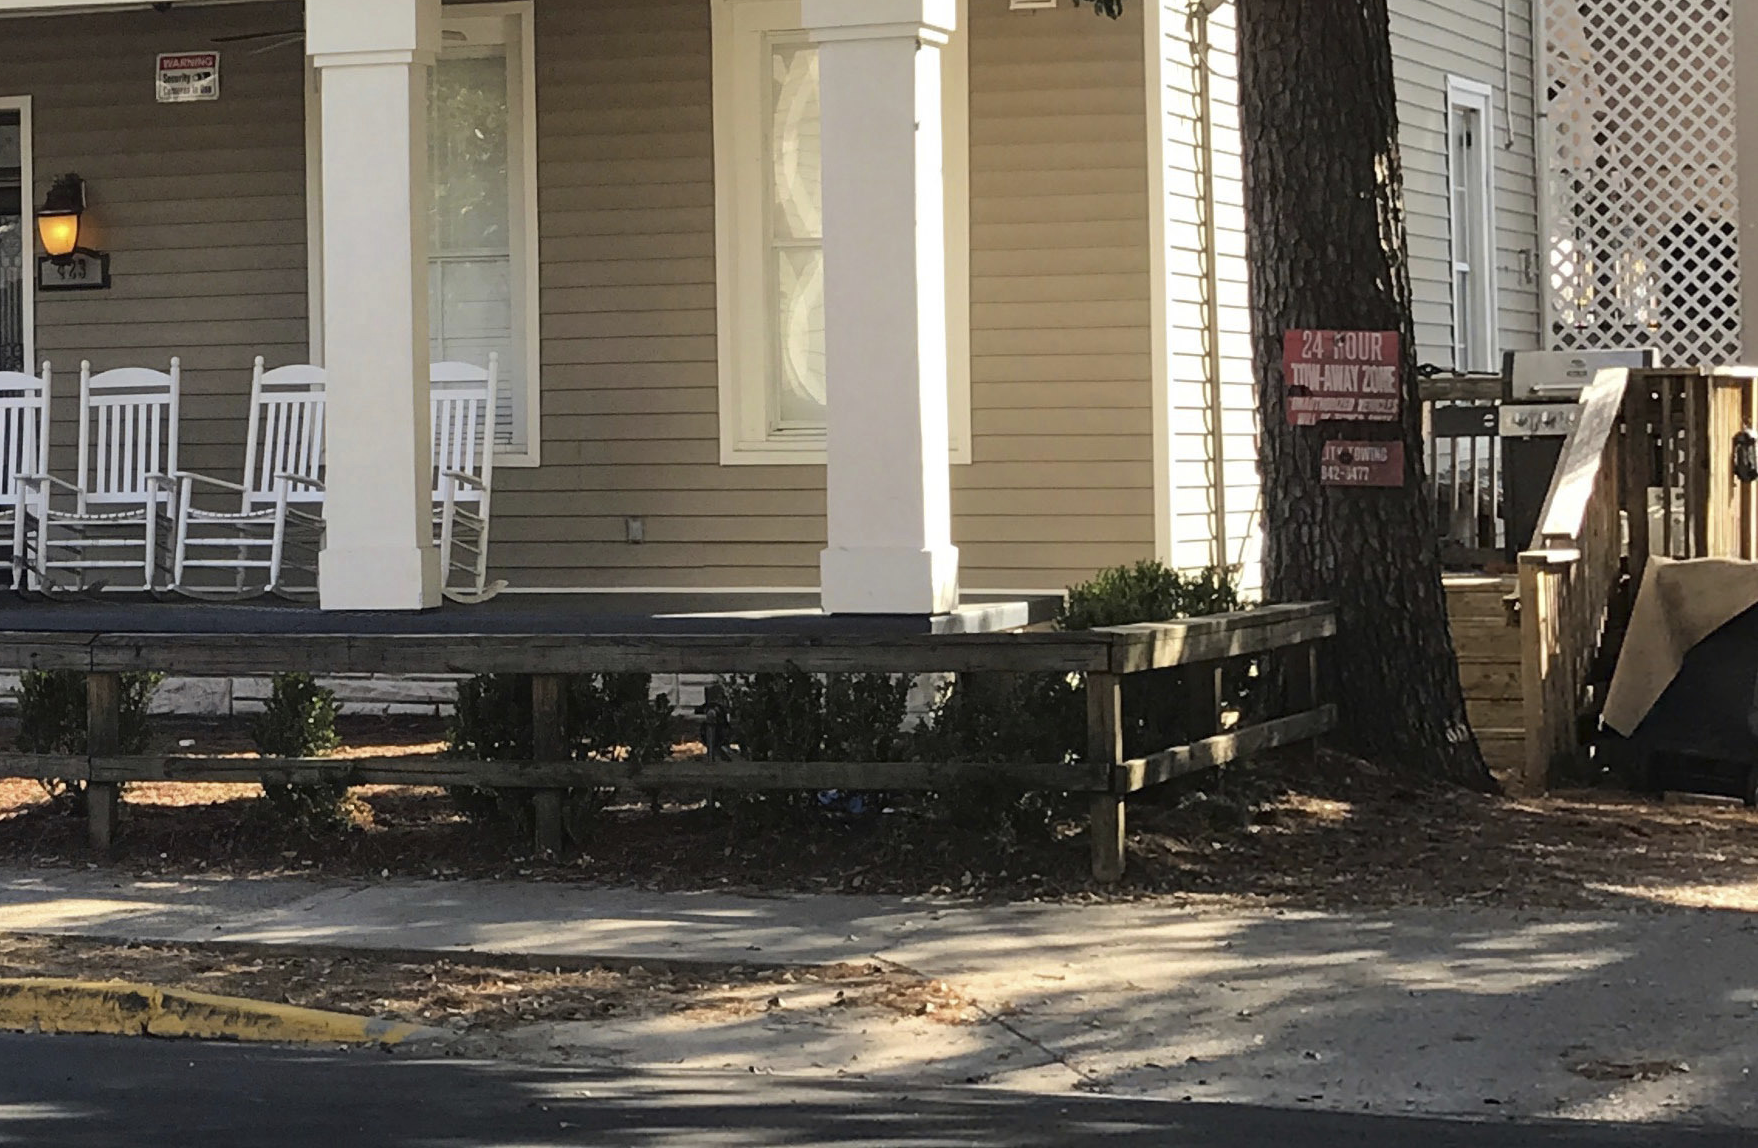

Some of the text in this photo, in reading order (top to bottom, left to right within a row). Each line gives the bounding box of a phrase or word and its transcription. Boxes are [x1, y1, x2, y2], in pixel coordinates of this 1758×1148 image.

[163, 57, 213, 69] WARNING
[1302, 330, 1383, 361] 24 HOUR
[1291, 362, 1396, 393] TOW-AWAY ZONE
